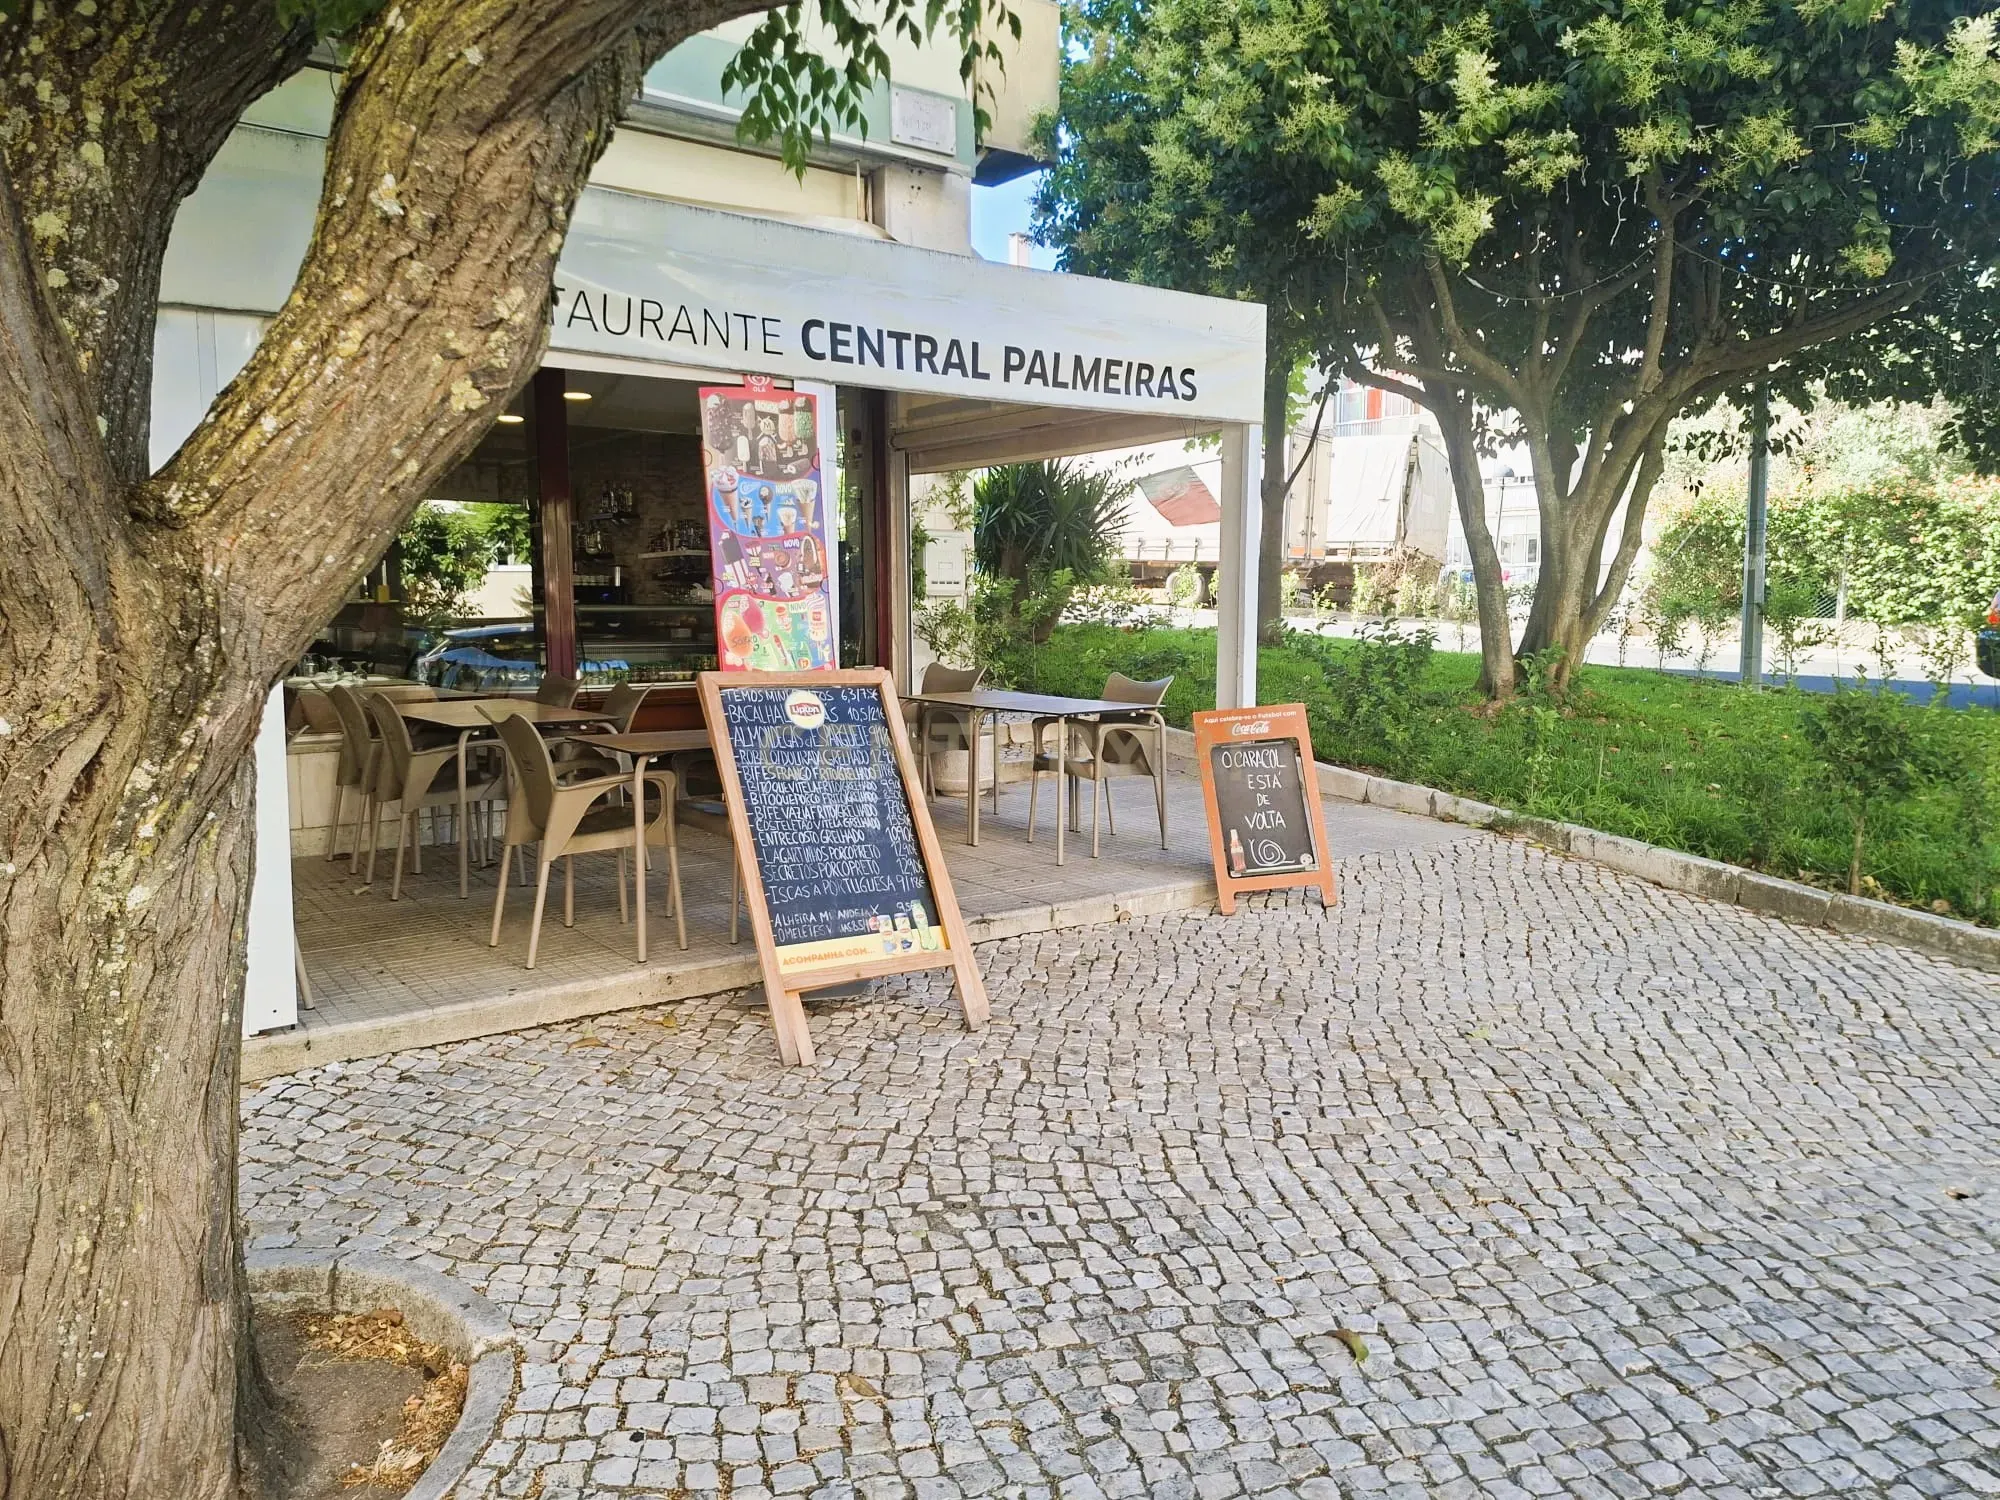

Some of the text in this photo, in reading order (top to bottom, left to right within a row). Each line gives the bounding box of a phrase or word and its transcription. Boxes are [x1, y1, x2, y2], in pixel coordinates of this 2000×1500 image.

[801, 318, 991, 381] CENTRAL
[1003, 345, 1198, 402] PALMEIRAS
[791, 703, 821, 716] Lipton
[1221, 748, 1288, 769] O CARACOL
[1247, 771, 1283, 790] ESTÁ
[1256, 793, 1271, 806] DE
[1244, 809, 1287, 831] VOLTA
[782, 950, 845, 966] ACOMPANHA
